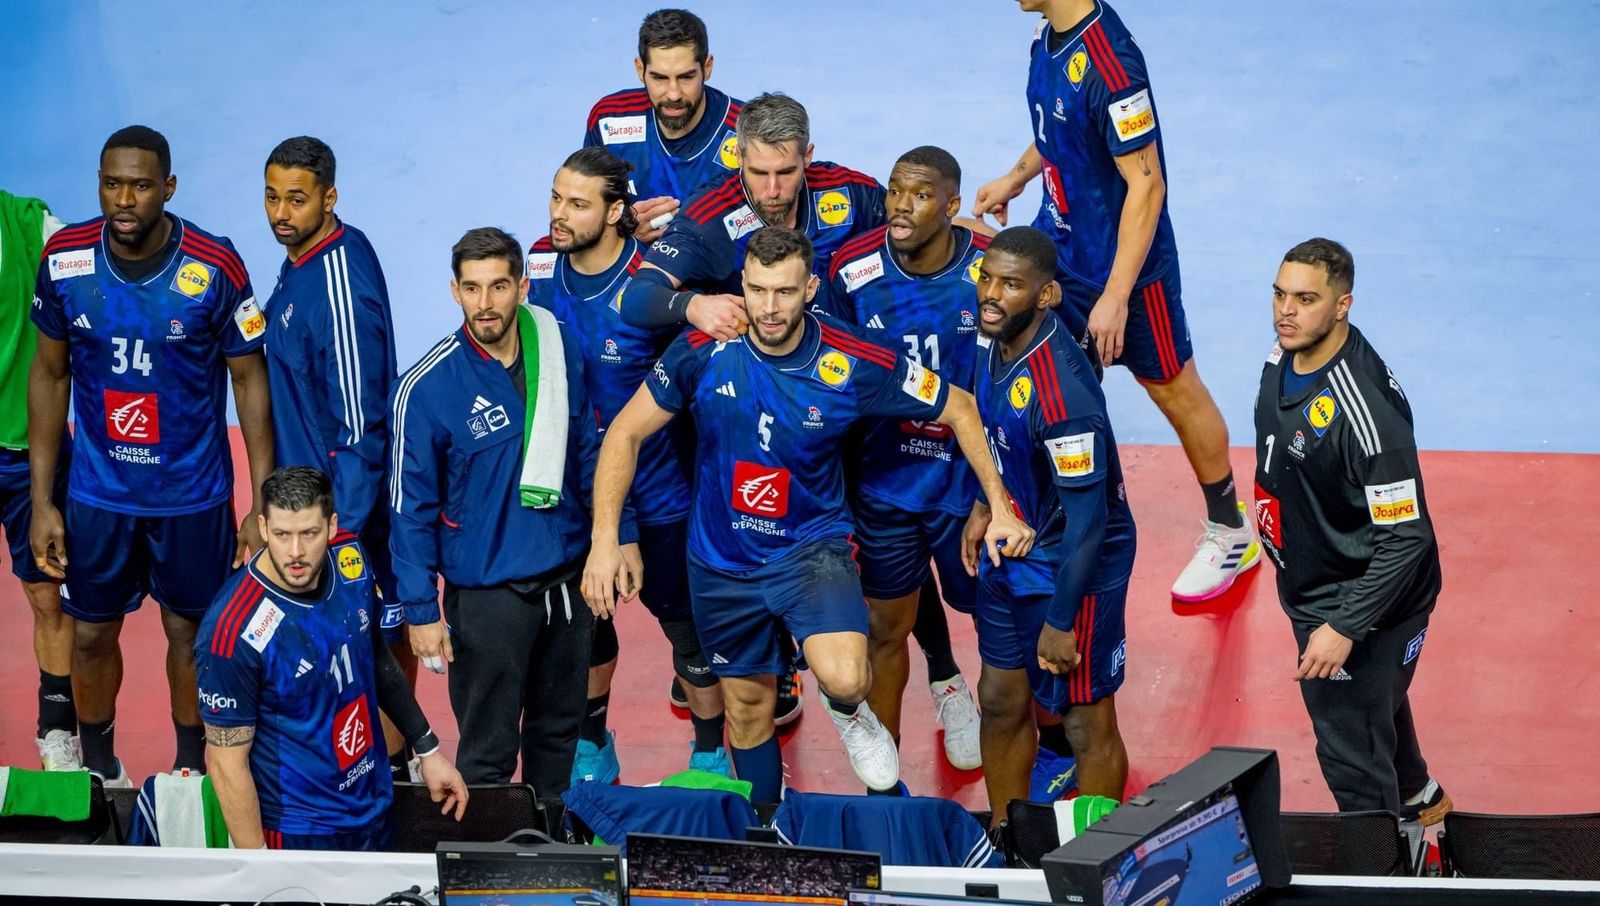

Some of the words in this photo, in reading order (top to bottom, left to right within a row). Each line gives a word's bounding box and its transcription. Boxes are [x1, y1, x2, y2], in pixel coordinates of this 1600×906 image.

[1036, 103, 1047, 144] 2
[59, 260, 92, 271] Butagaz
[848, 263, 880, 281] Butagaz
[111, 337, 152, 376] 34
[903, 334, 940, 371] 31
[758, 412, 774, 452] 5
[115, 445, 151, 456] CAISSE
[900, 444, 952, 462] D'EPARGNE
[910, 438, 945, 451] CAISSE
[108, 449, 161, 464] D'EPARGNE
[1265, 434, 1275, 474] 1
[1058, 457, 1091, 470] Josera
[1373, 504, 1415, 518] Josera
[732, 520, 786, 536] D'EPARGNE
[740, 514, 776, 529] CAISSE
[254, 607, 277, 638] Butagaz
[329, 643, 354, 694] 11
